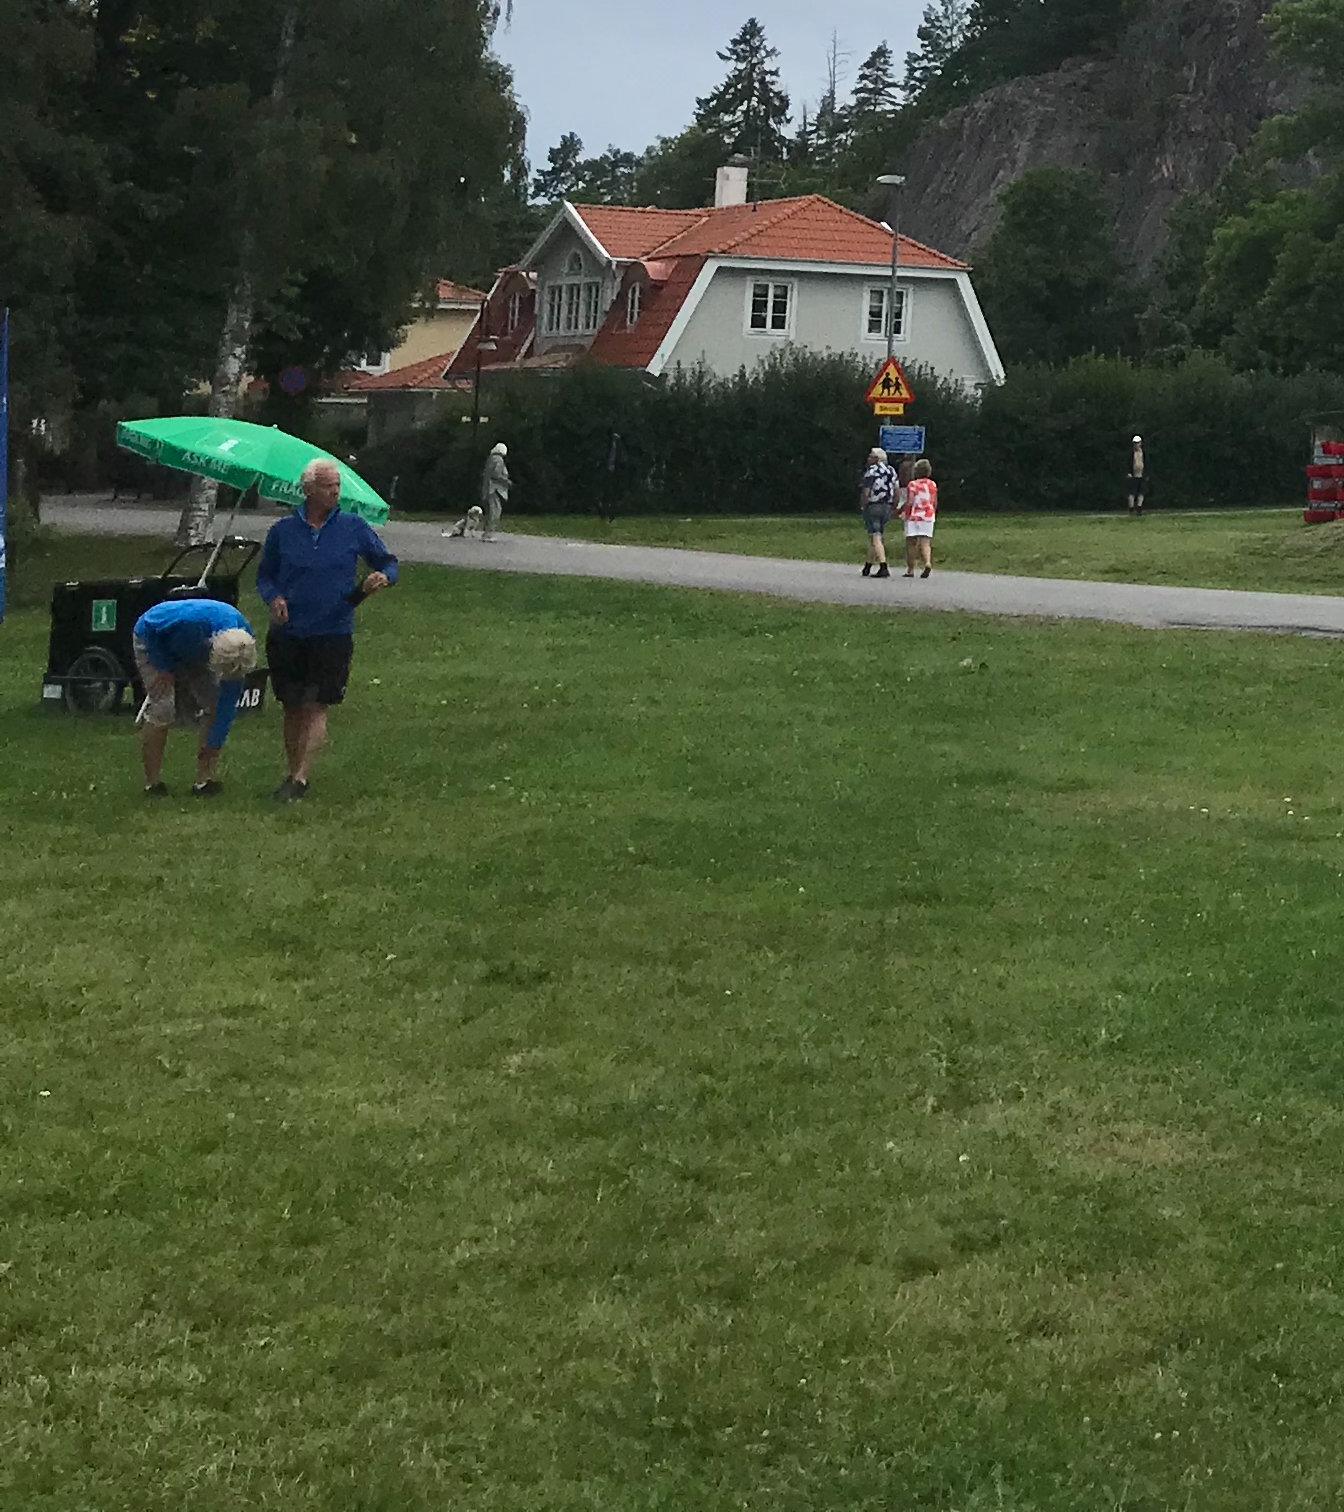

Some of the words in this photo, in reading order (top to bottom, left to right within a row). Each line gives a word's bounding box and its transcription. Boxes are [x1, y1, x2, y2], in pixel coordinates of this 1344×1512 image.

[181, 451, 206, 467] ASK
[209, 458, 230, 474] ME
[234, 688, 260, 708] AB
